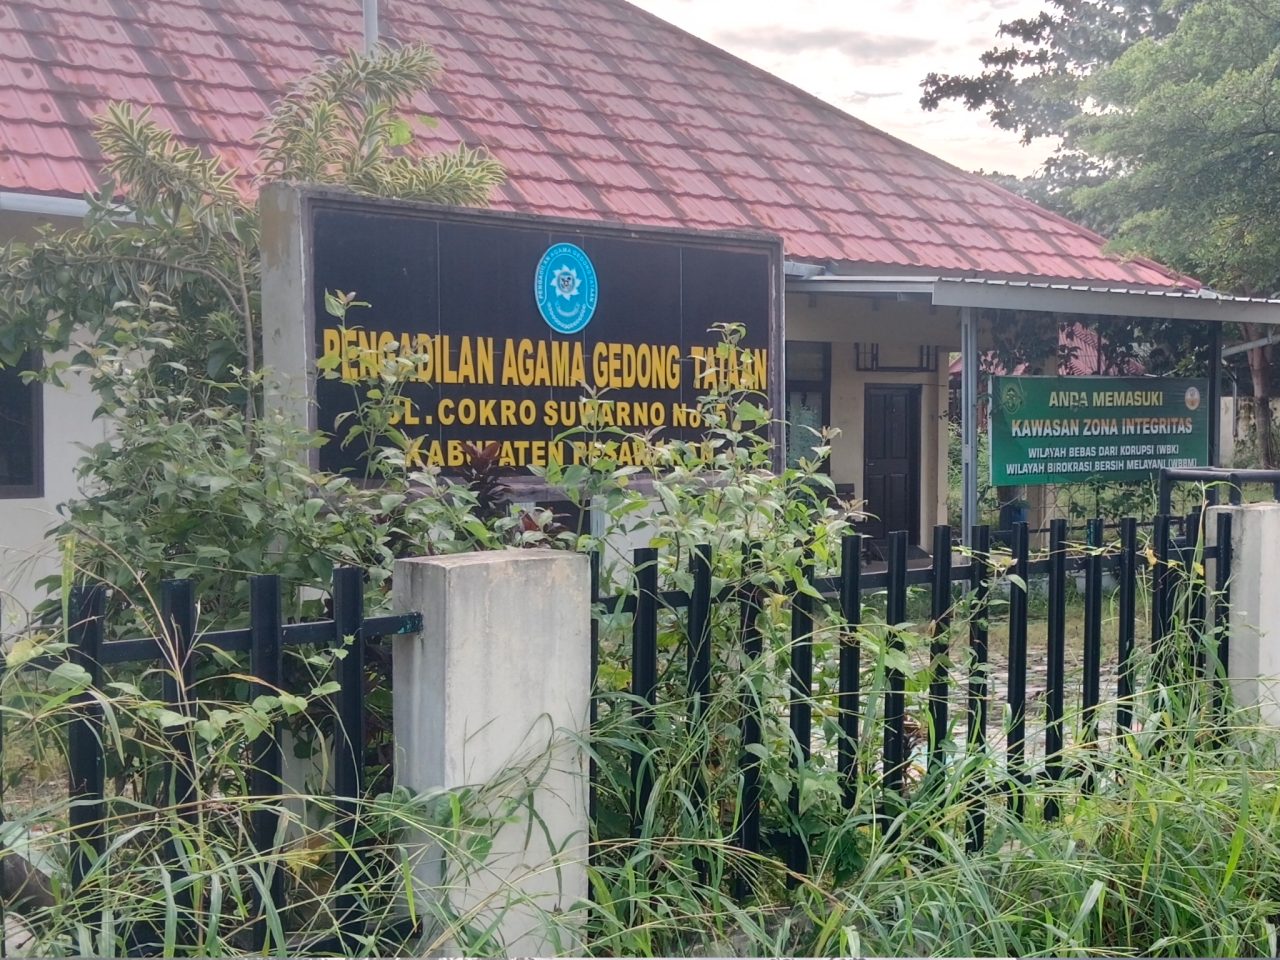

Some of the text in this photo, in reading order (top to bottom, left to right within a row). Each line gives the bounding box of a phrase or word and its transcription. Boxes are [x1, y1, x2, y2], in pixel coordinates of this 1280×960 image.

[502, 338, 585, 387] AGAMA
[593, 341, 680, 389] GEDONG
[690, 345, 767, 390] TATAAN
[1048, 391, 1163, 407] ANDA MEMASUKI
[437, 398, 537, 426] COKRO
[543, 400, 666, 426] SUWARNO
[1011, 417, 1193, 437] KAWASAN ZONA INTEGRITAS
[1028, 443, 1179, 459] WILAYAH BEBAS DARI KORUPSI (WBK)
[1006, 463, 1045, 475] WILAYAH
[1047, 461, 1092, 473] BIROKRASI
[1094, 460, 1124, 471] BERSIH
[1126, 459, 1166, 470] MELAYANI
